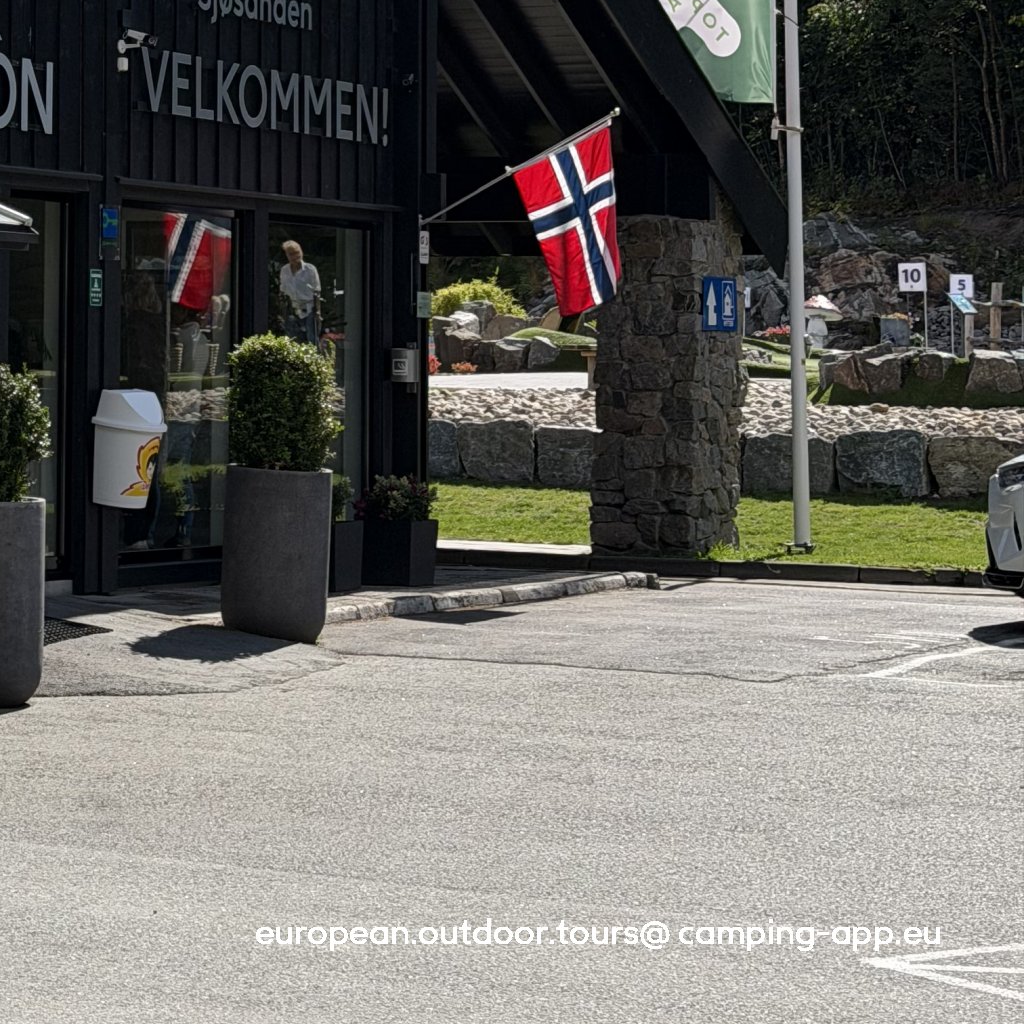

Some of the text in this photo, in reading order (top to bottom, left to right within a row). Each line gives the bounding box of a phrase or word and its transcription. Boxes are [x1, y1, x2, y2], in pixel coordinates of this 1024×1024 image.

[141, 46, 390, 147] VELKOMMEN!
[901, 268, 921, 283] 10
[957, 279, 966, 291] 5
